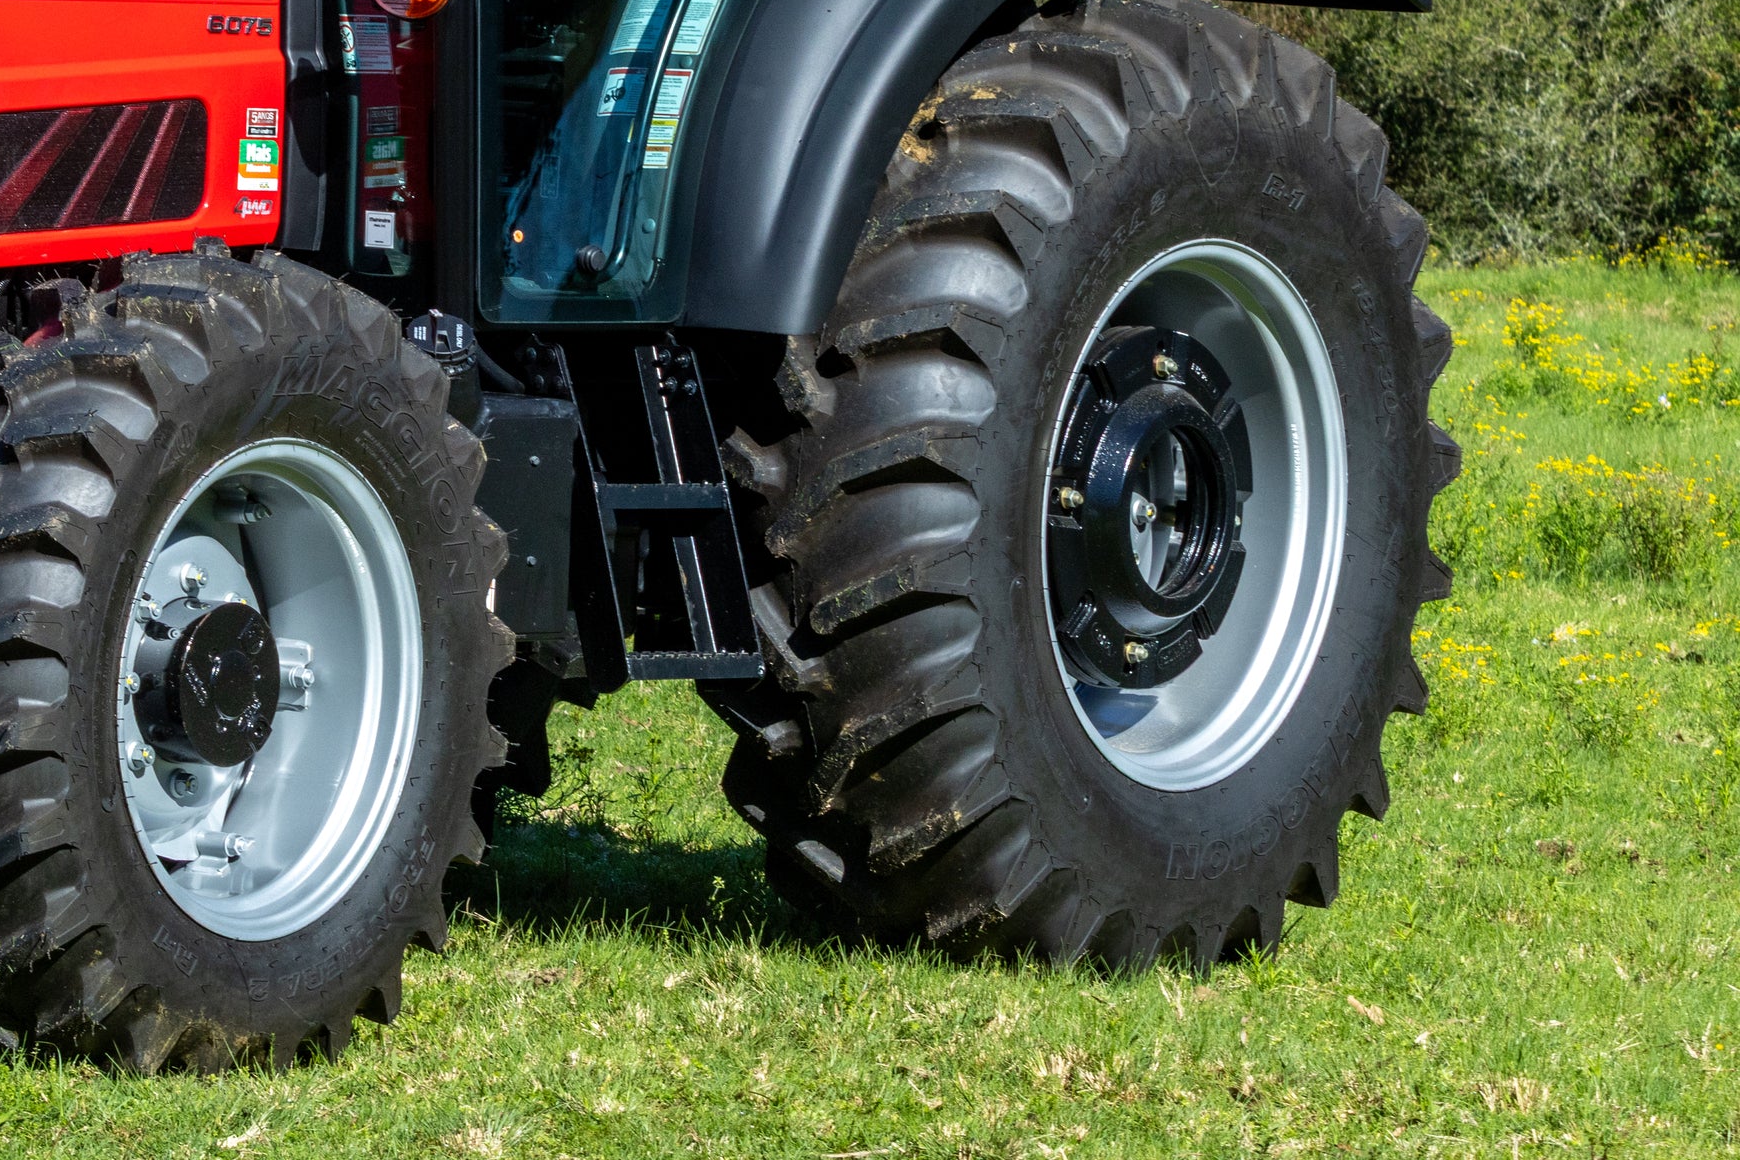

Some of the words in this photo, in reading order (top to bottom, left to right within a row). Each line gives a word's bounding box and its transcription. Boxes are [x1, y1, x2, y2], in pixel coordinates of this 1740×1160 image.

[207, 15, 273, 36] 6075
[251, 112, 258, 124] 5
[258, 112, 275, 121] ANOS
[245, 143, 272, 162] Mais
[1262, 172, 1306, 211] R-1
[272, 354, 478, 595] MAGGION
